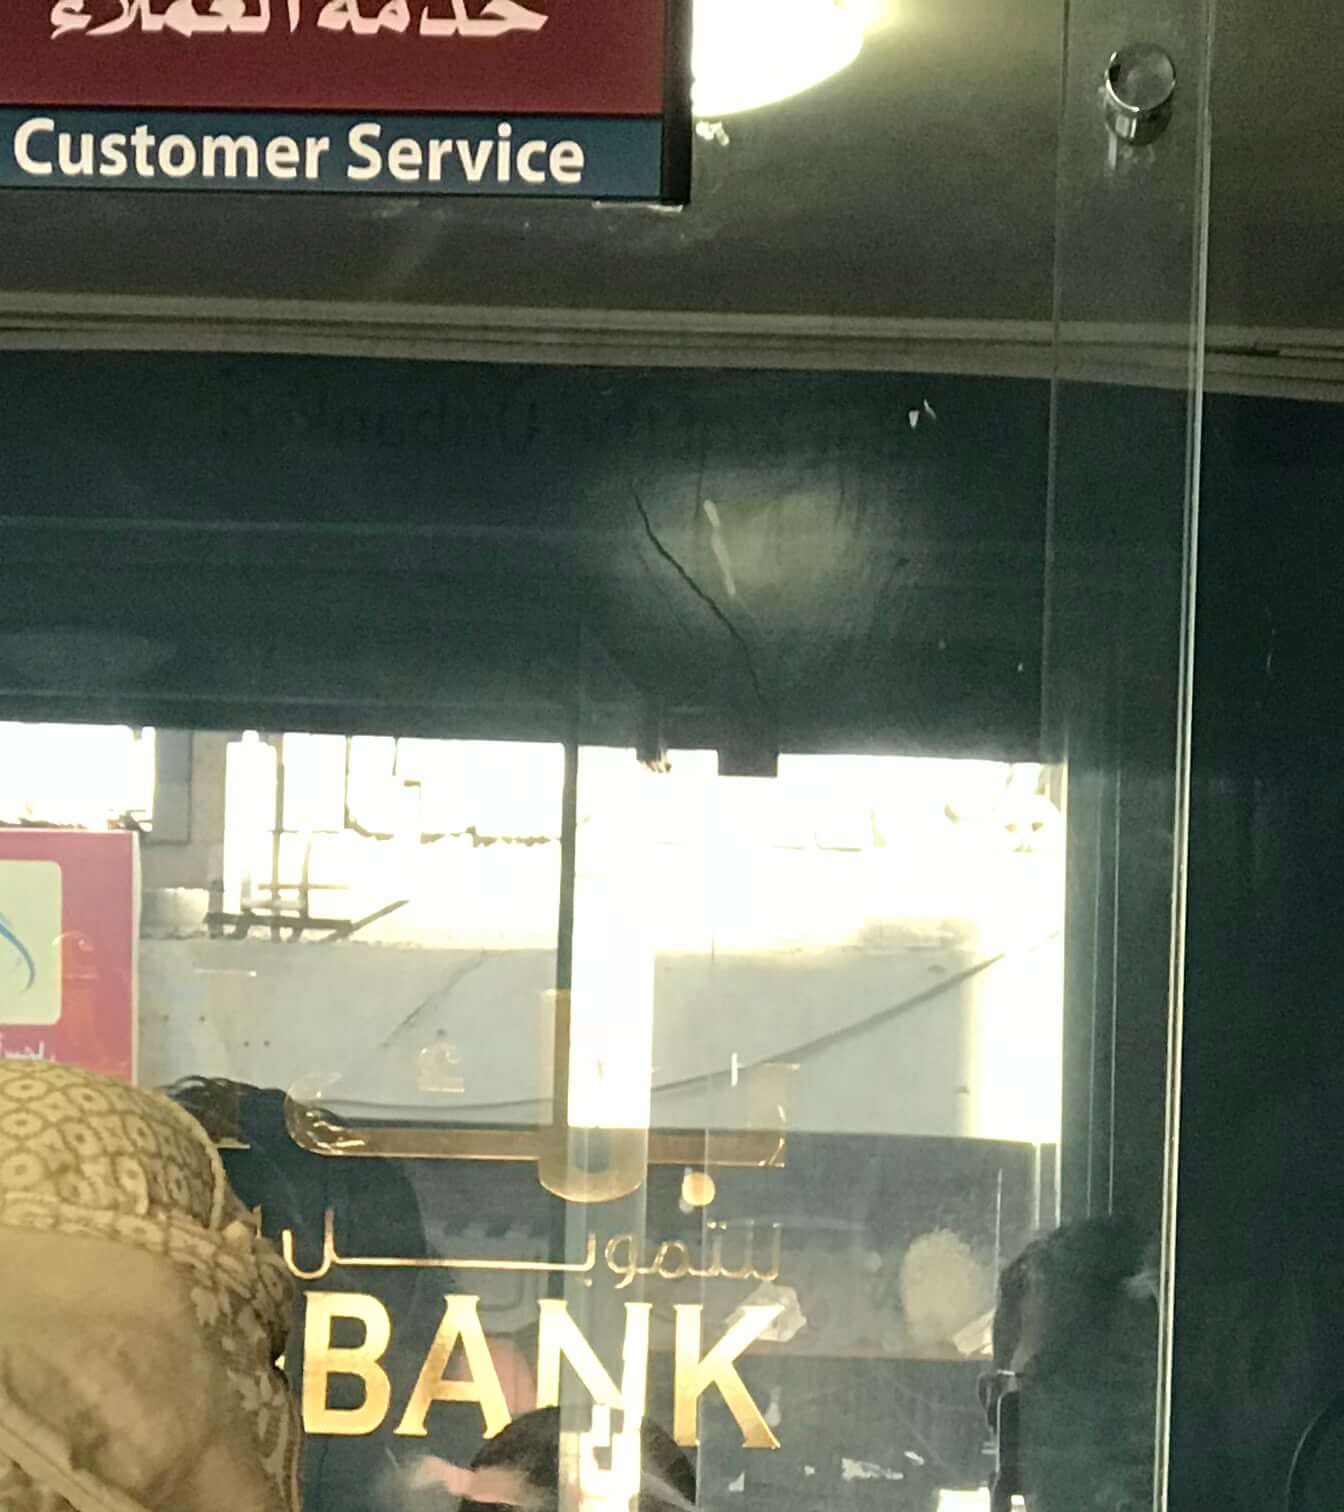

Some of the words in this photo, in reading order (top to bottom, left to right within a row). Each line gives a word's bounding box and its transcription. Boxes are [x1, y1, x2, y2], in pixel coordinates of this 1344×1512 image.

[12, 117, 329, 179] Customer
[347, 122, 585, 184] Service
[301, 1290, 782, 1451] BANK
